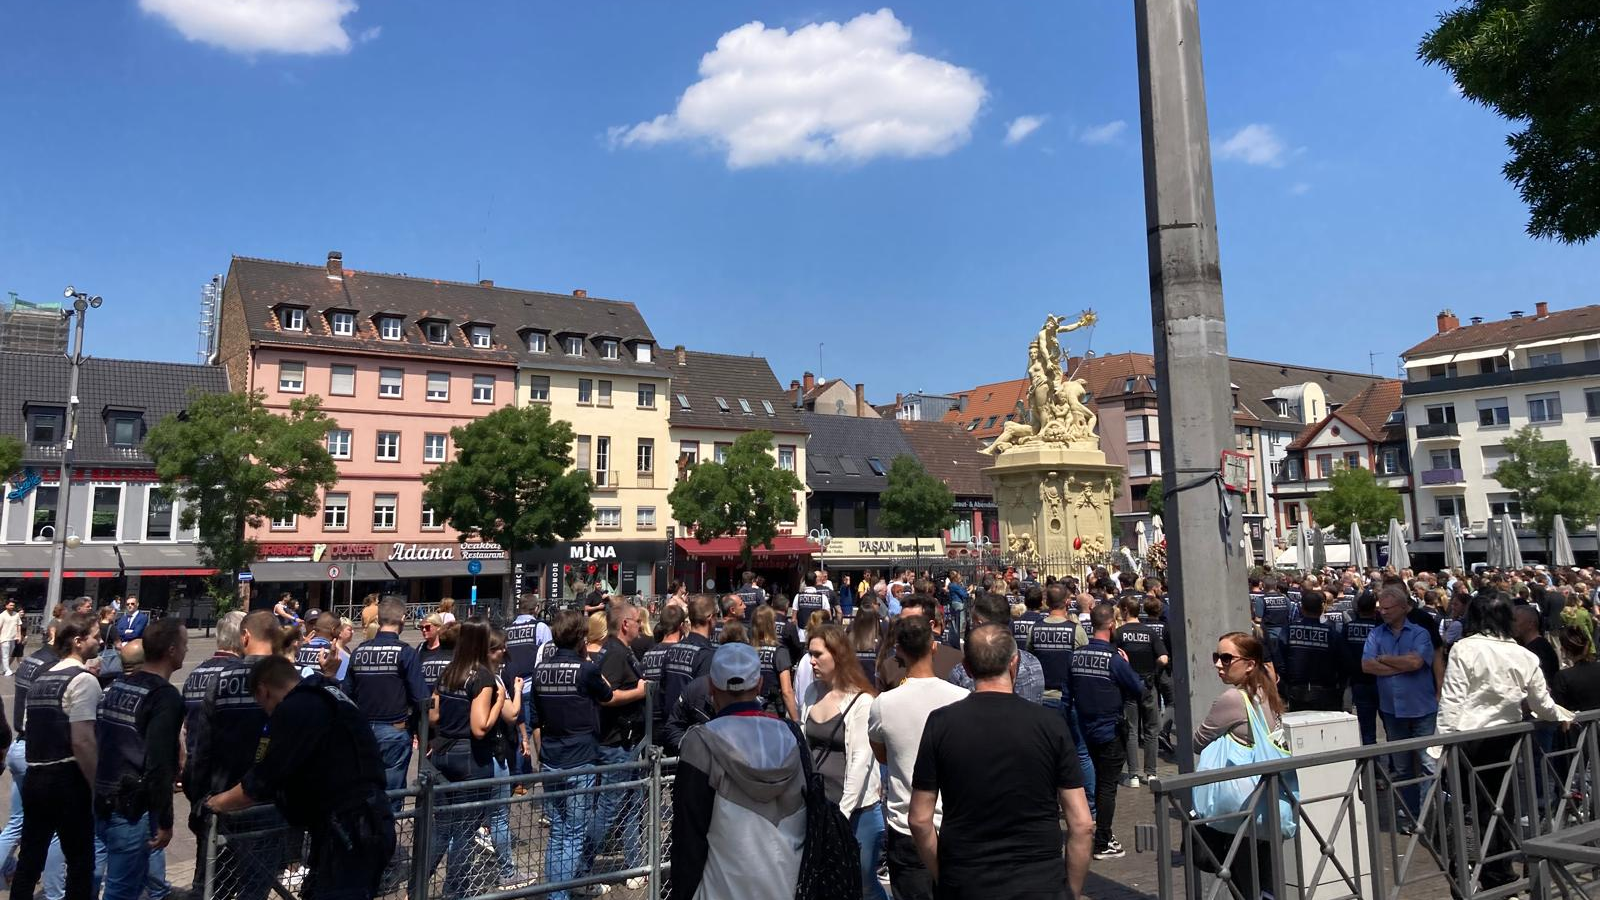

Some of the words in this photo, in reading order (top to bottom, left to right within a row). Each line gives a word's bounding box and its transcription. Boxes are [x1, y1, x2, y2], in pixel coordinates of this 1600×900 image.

[388, 543, 454, 560] Adana
[897, 543, 936, 552] Resturant
[461, 551, 505, 559] Restaurant
[507, 628, 534, 641] OLIZEI
[1034, 631, 1071, 643] POLIZEI
[1122, 632, 1150, 642] POLIZEI
[1290, 628, 1328, 641] POLIZEI
[355, 651, 399, 664] POLIZEI
[1072, 655, 1110, 670] POLIZEI
[536, 669, 577, 685] POLIZEI
